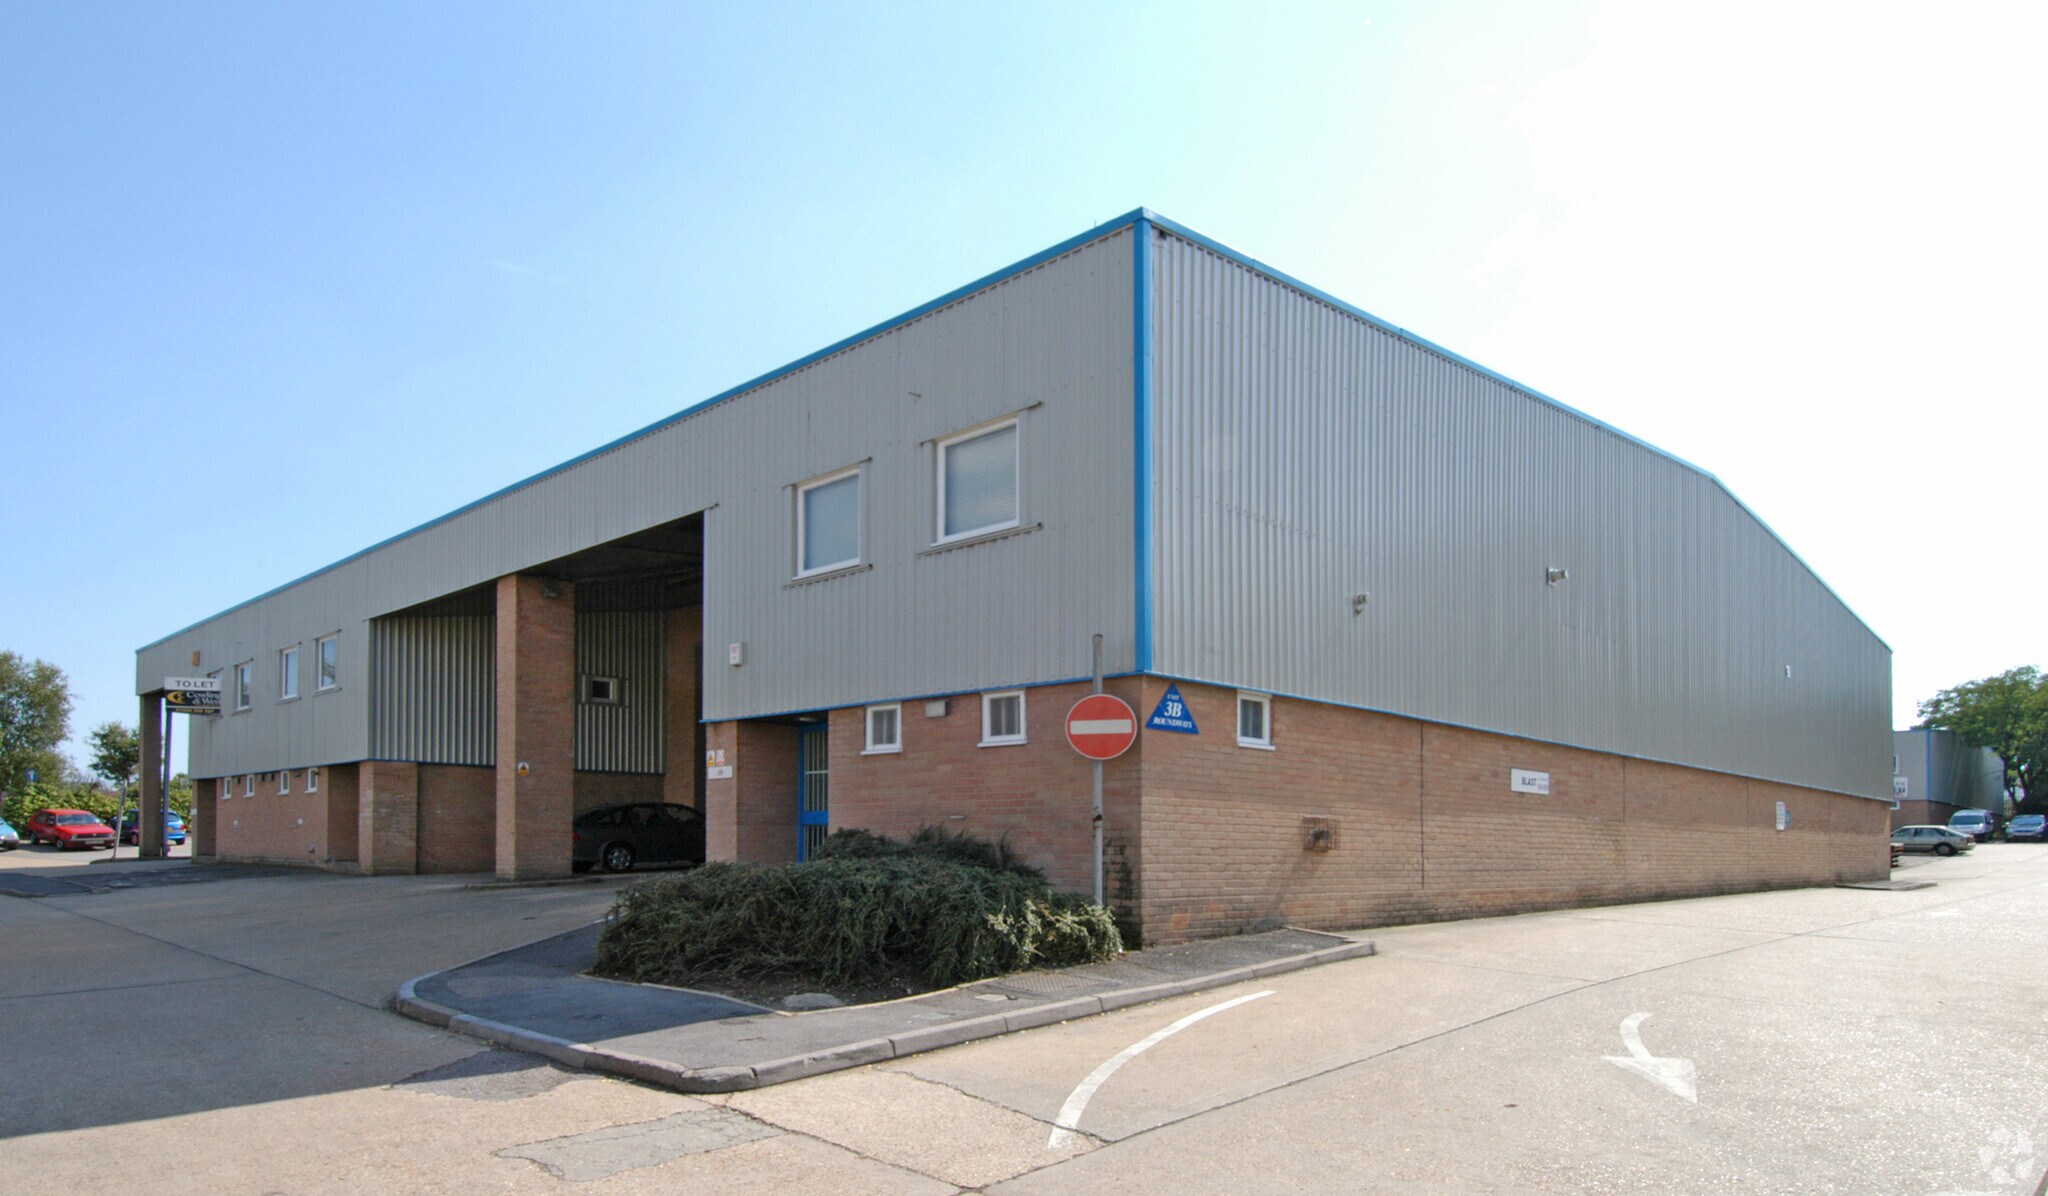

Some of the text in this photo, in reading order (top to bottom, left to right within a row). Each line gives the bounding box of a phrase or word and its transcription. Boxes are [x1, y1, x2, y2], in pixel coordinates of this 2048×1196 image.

[175, 680, 215, 688] TO LET
[1164, 701, 1182, 718] 3B
[1521, 776, 1537, 787] BLAST
